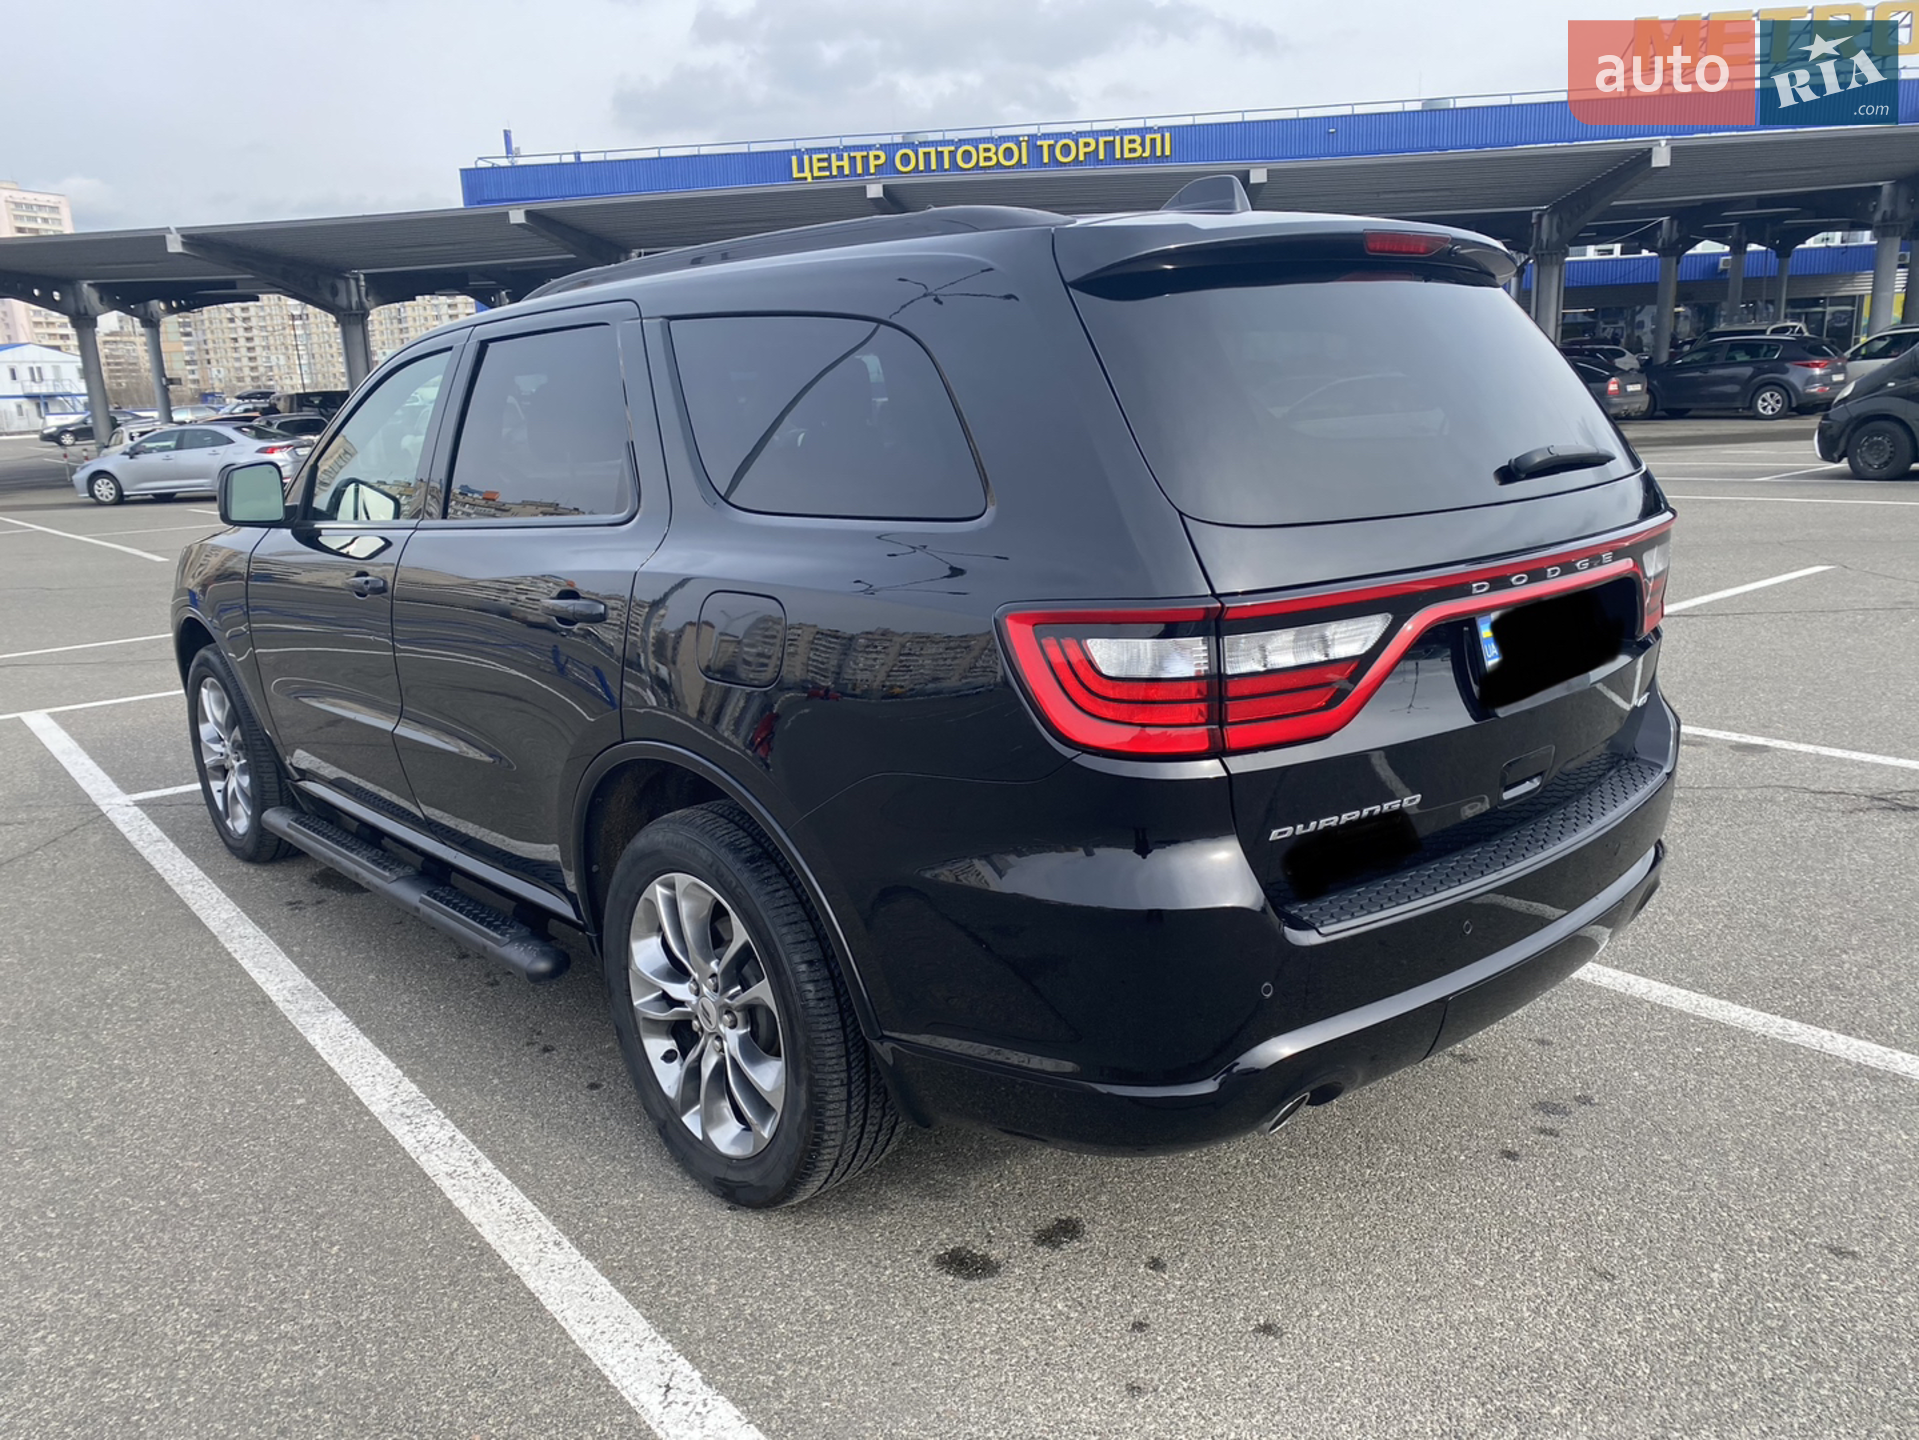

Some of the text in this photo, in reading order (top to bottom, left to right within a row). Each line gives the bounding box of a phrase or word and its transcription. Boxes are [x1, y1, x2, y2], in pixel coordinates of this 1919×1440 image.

[791, 132, 1172, 182] ЦЕНТР ОПТОВОЇ ТОРГІВЛІ
[1471, 552, 1614, 594] DODGE
[1484, 642, 1500, 658] UA
[1268, 793, 1422, 841] DURANGO
